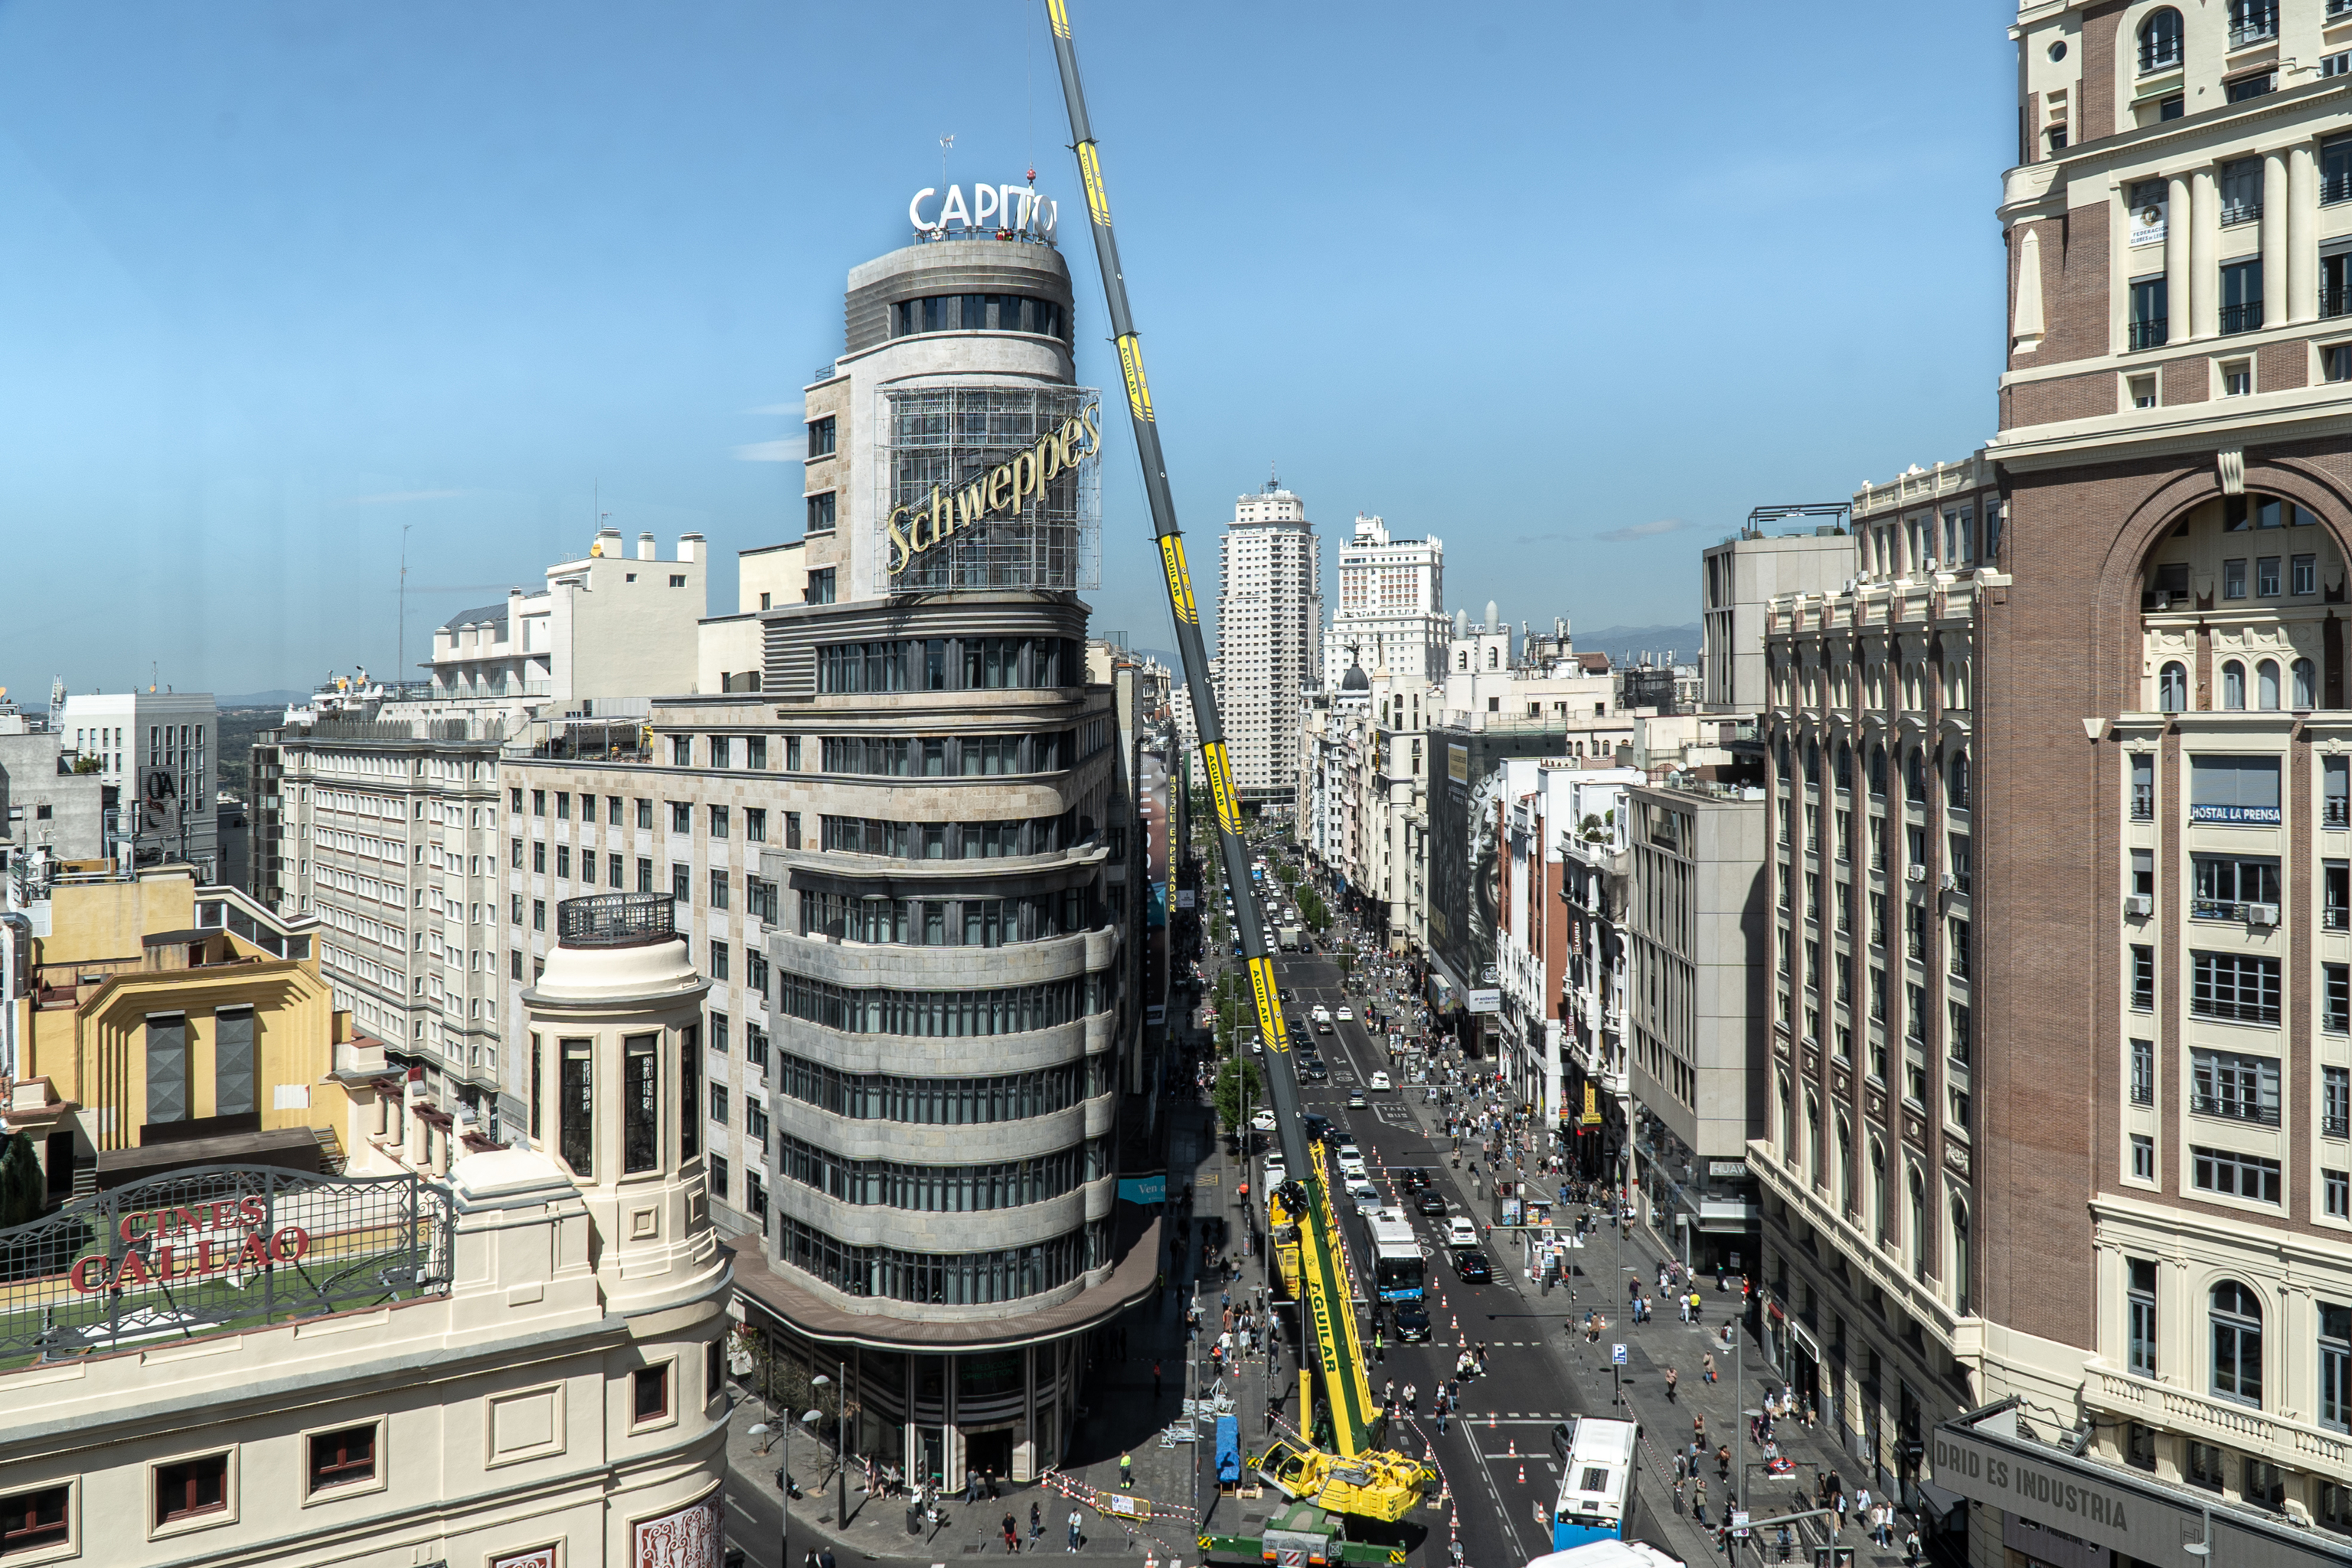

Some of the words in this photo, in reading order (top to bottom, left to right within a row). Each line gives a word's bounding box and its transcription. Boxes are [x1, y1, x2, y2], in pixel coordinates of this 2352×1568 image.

[1081, 153, 1093, 190] AGUILAR
[1122, 347, 1137, 395] AGUILAR
[886, 402, 1100, 575] Schweppes
[1165, 547, 1180, 597] AGUILAR
[1208, 755, 1224, 807] AGUILAR
[2192, 805, 2228, 818] HOSTAL
[2230, 808, 2242, 819] LA
[2243, 808, 2281, 821] PRENSA
[1253, 969, 1269, 1024] AGUILAR
[1138, 1184, 1157, 1194] Ven
[119, 1194, 268, 1243] CINES
[70, 1226, 310, 1294] CALLAO
[1310, 1282, 1337, 1373] AGUILAR
[1614, 1345, 1625, 1357] P
[1936, 1439, 1980, 1478] DRID
[1988, 1456, 2009, 1488] ES
[2016, 1467, 2128, 1531] INDUSTRIA
